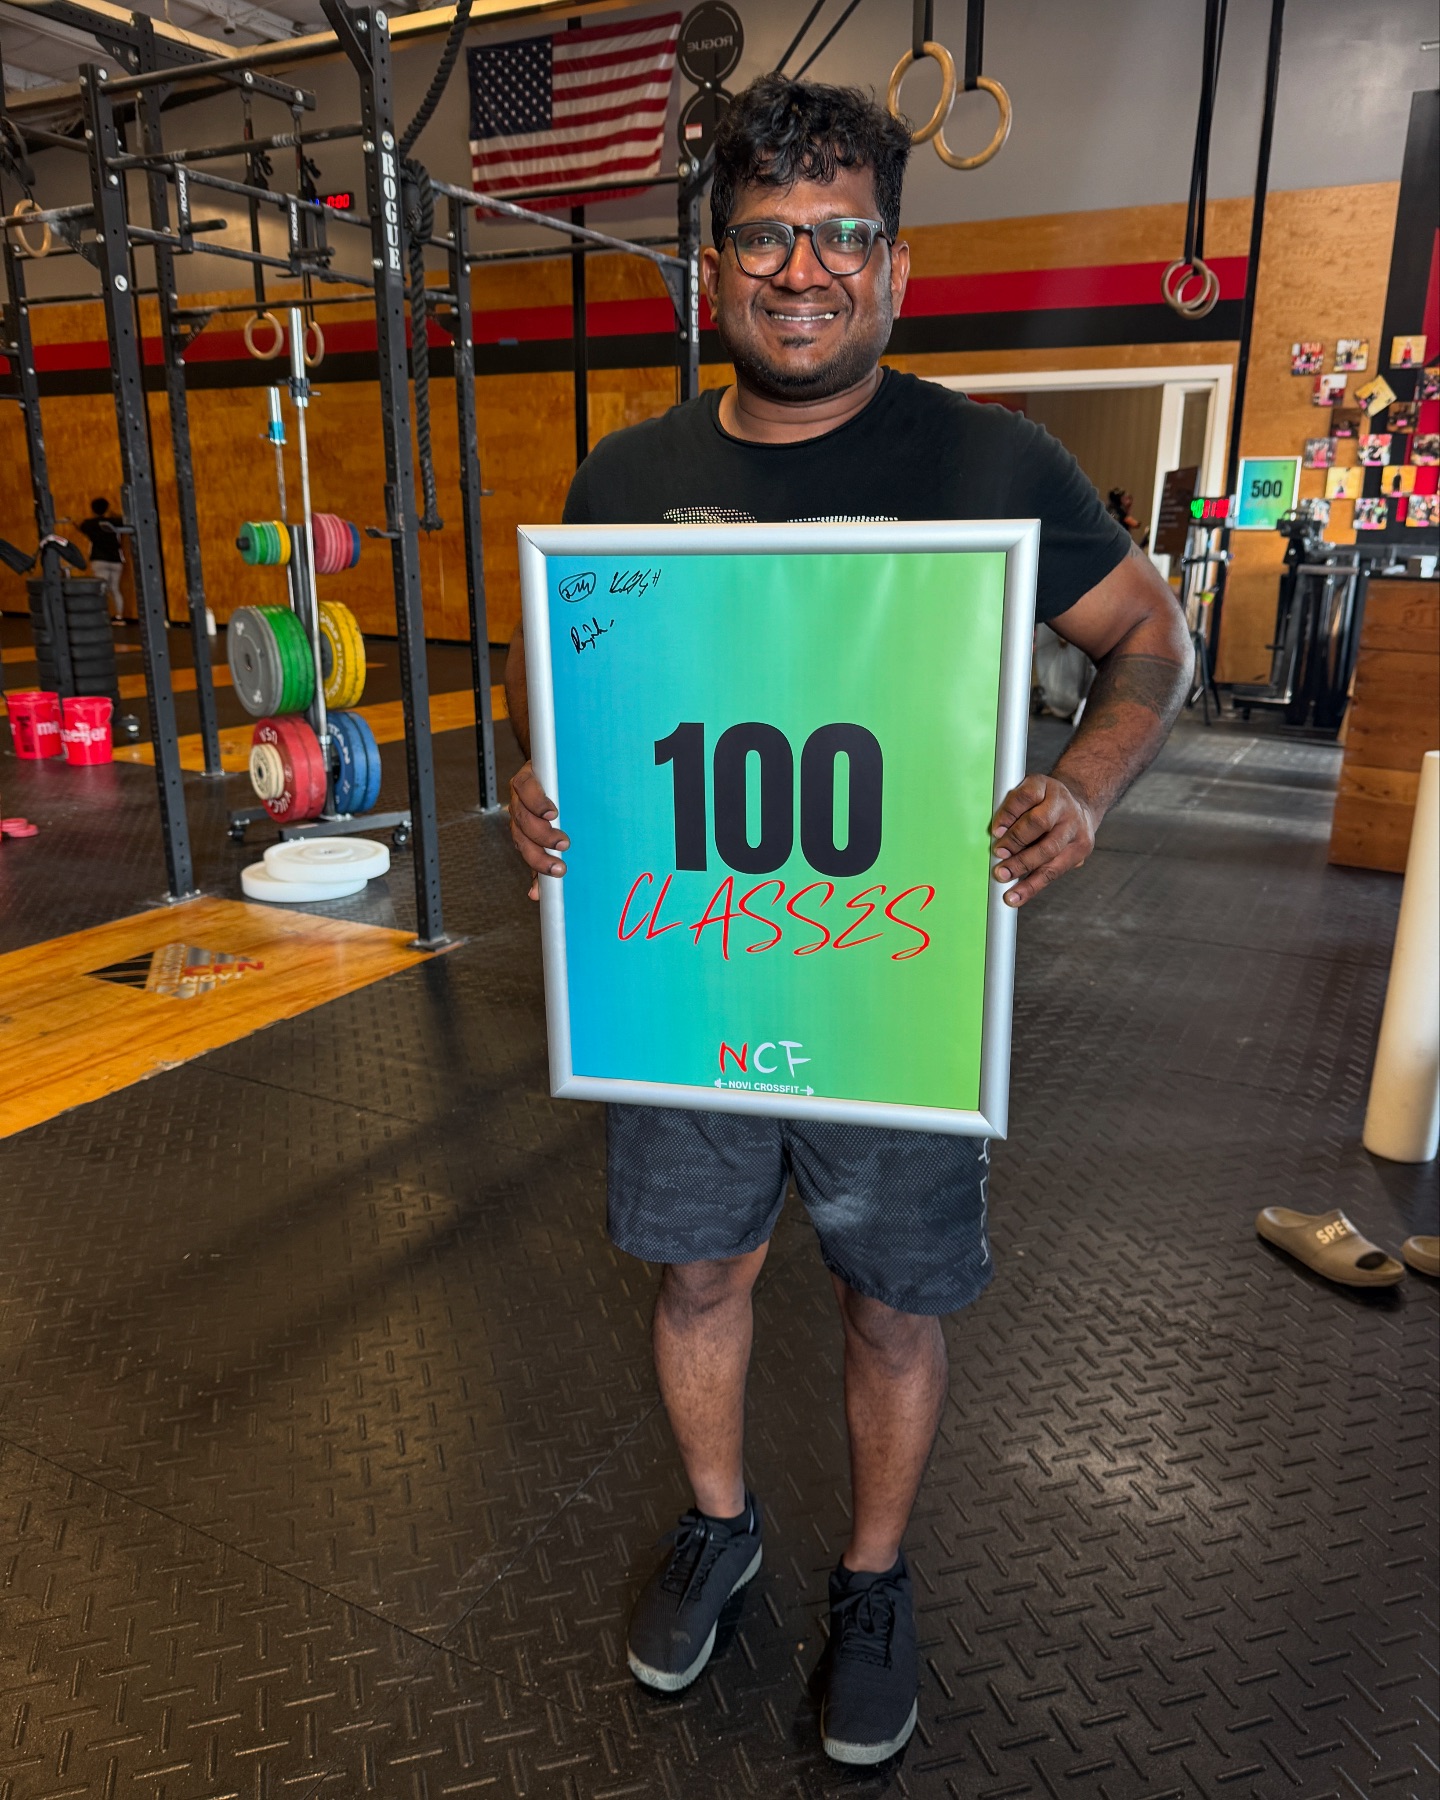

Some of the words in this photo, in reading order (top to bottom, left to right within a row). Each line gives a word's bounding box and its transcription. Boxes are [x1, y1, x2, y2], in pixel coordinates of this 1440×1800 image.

[178, 170, 188, 213] ROGUE
[381, 152, 401, 270] ROGUE
[690, 259, 700, 344] ROGUE
[1251, 479, 1283, 498] 500
[654, 721, 884, 878] 100
[617, 872, 936, 961] CLASSES
[181, 971, 243, 984] NOVI
[184, 961, 265, 976] CFN
[719, 1040, 812, 1079] NCF
[728, 1080, 752, 1090] NOVI
[753, 1082, 800, 1094] CROSSFIT
